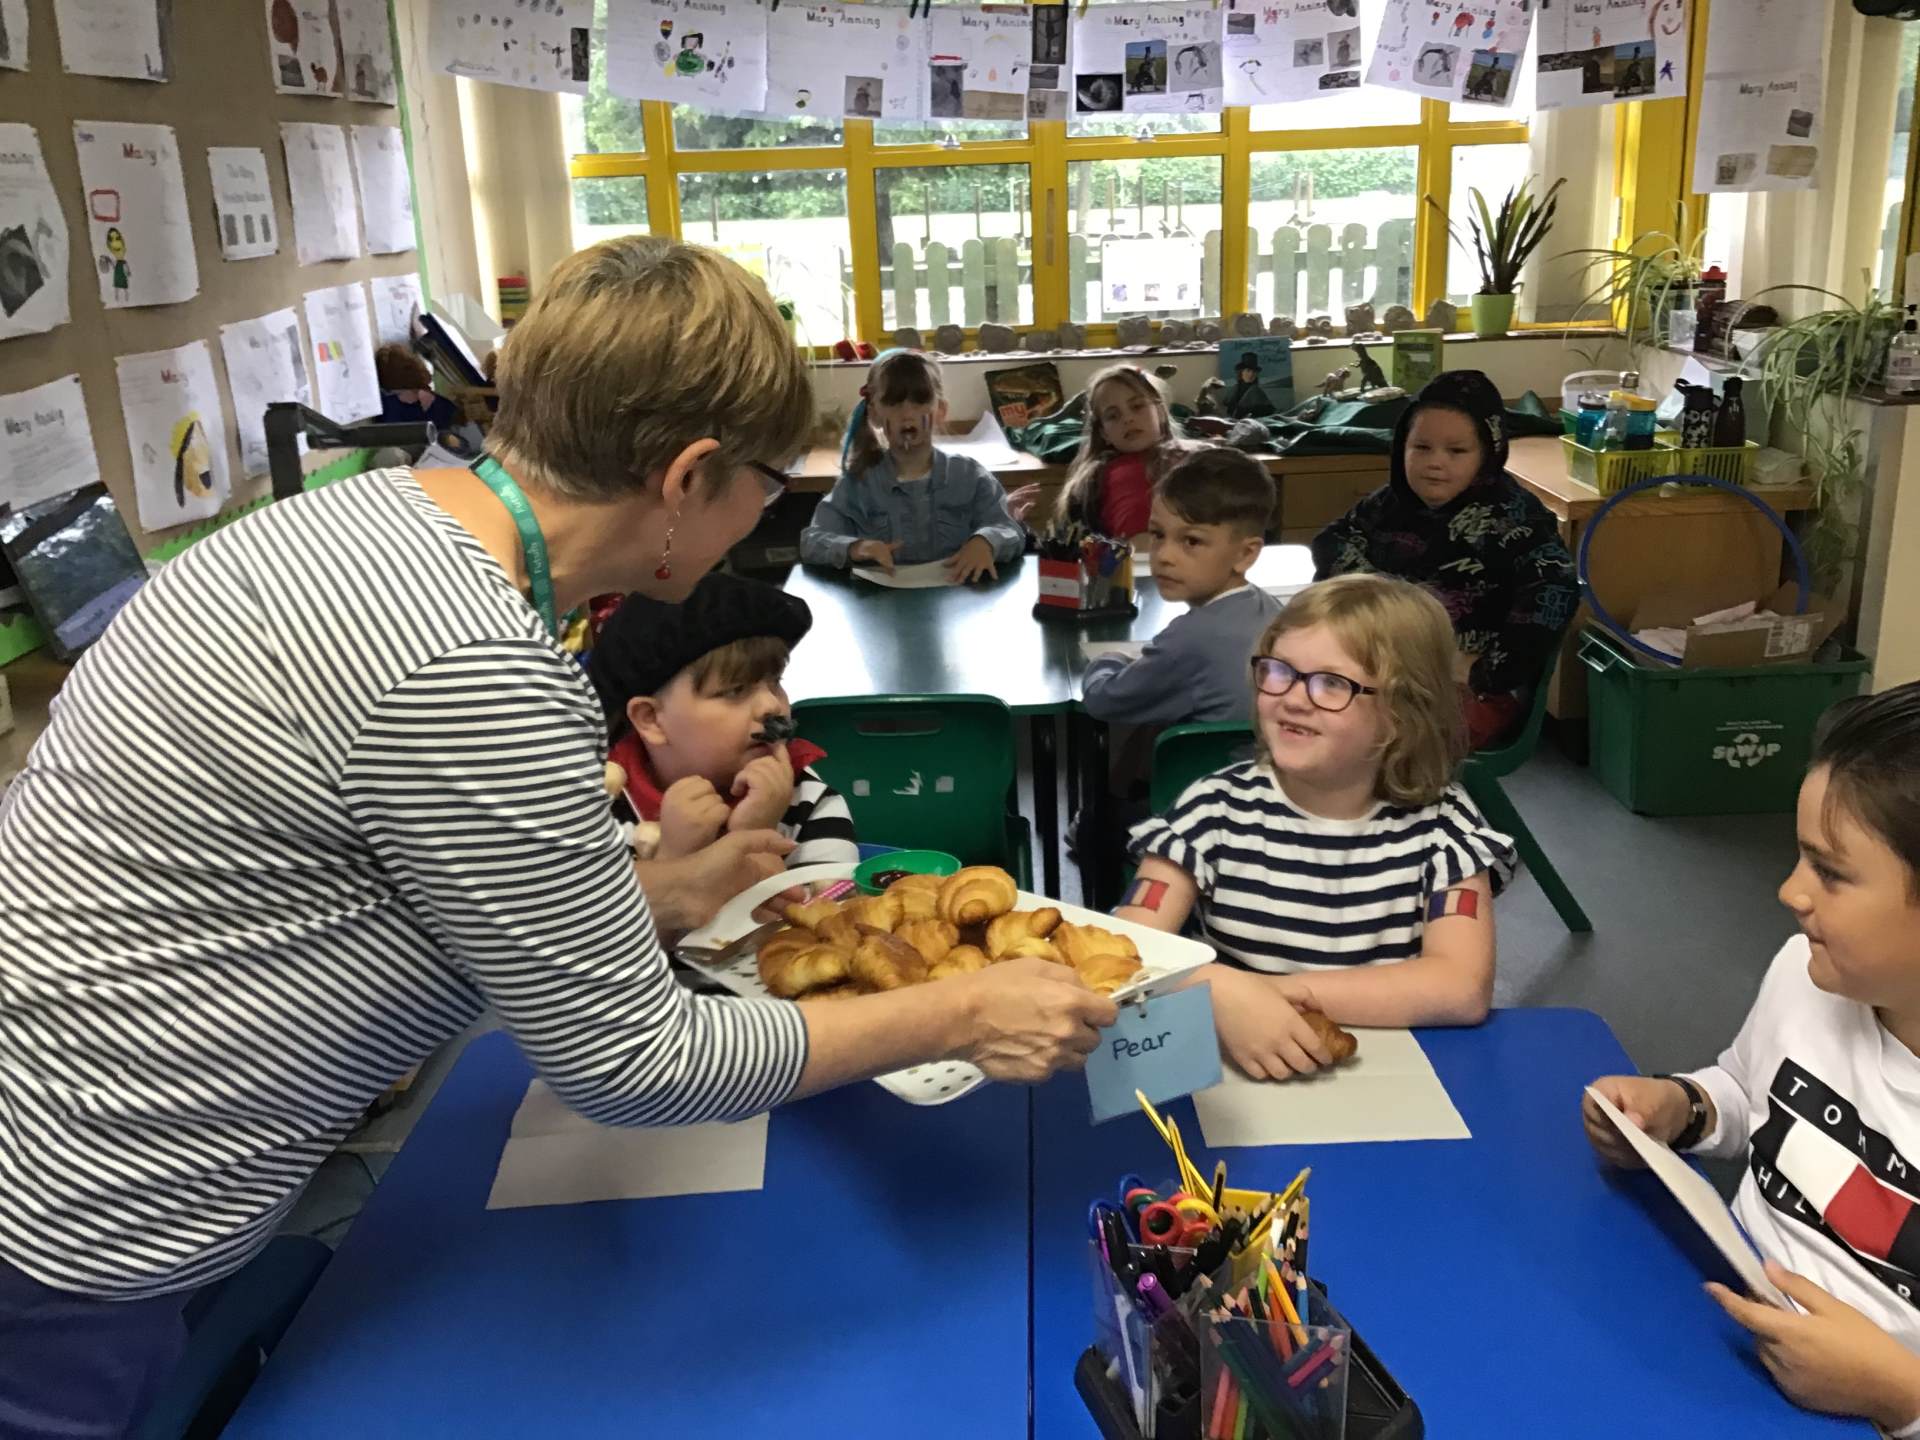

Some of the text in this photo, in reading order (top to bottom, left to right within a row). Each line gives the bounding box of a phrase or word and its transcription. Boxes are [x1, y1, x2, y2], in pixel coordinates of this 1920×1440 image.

[1574, 4, 1601, 15] Mary
[806, 11, 881, 29] Mary Anning
[962, 16, 990, 31] Mary
[1114, 14, 1184, 29] Mary Anning
[1739, 83, 1764, 97] Mary
[1112, 1031, 1172, 1060] Pear
